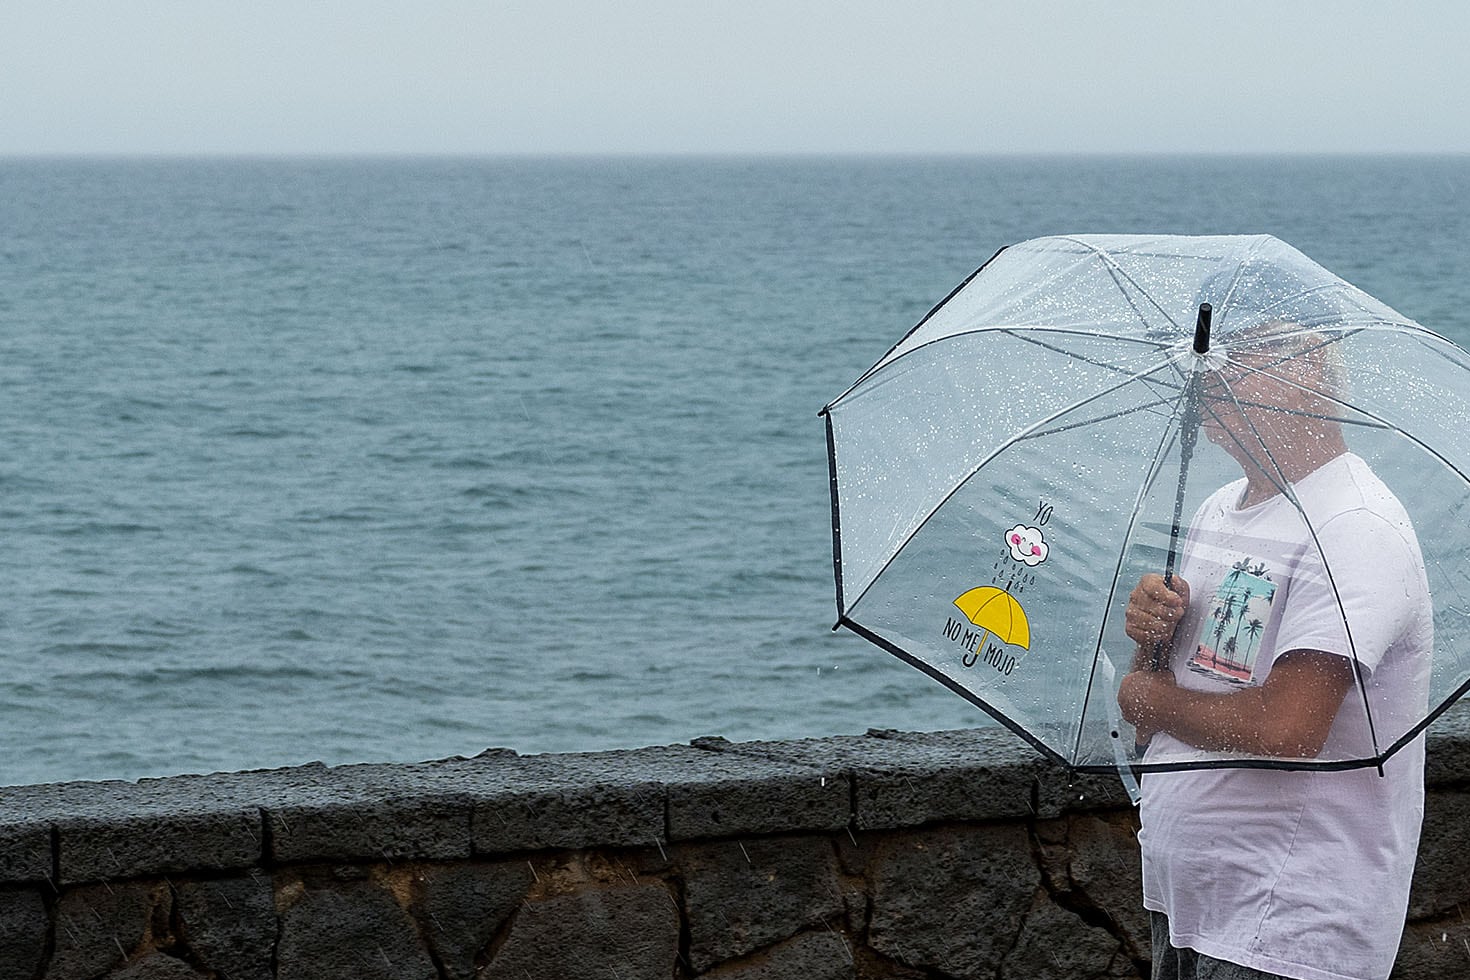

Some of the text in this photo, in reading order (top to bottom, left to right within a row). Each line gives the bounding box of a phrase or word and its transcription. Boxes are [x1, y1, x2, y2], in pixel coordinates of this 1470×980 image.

[1033, 501, 1053, 526] YO
[943, 618, 1016, 676] NO ME MOJO
